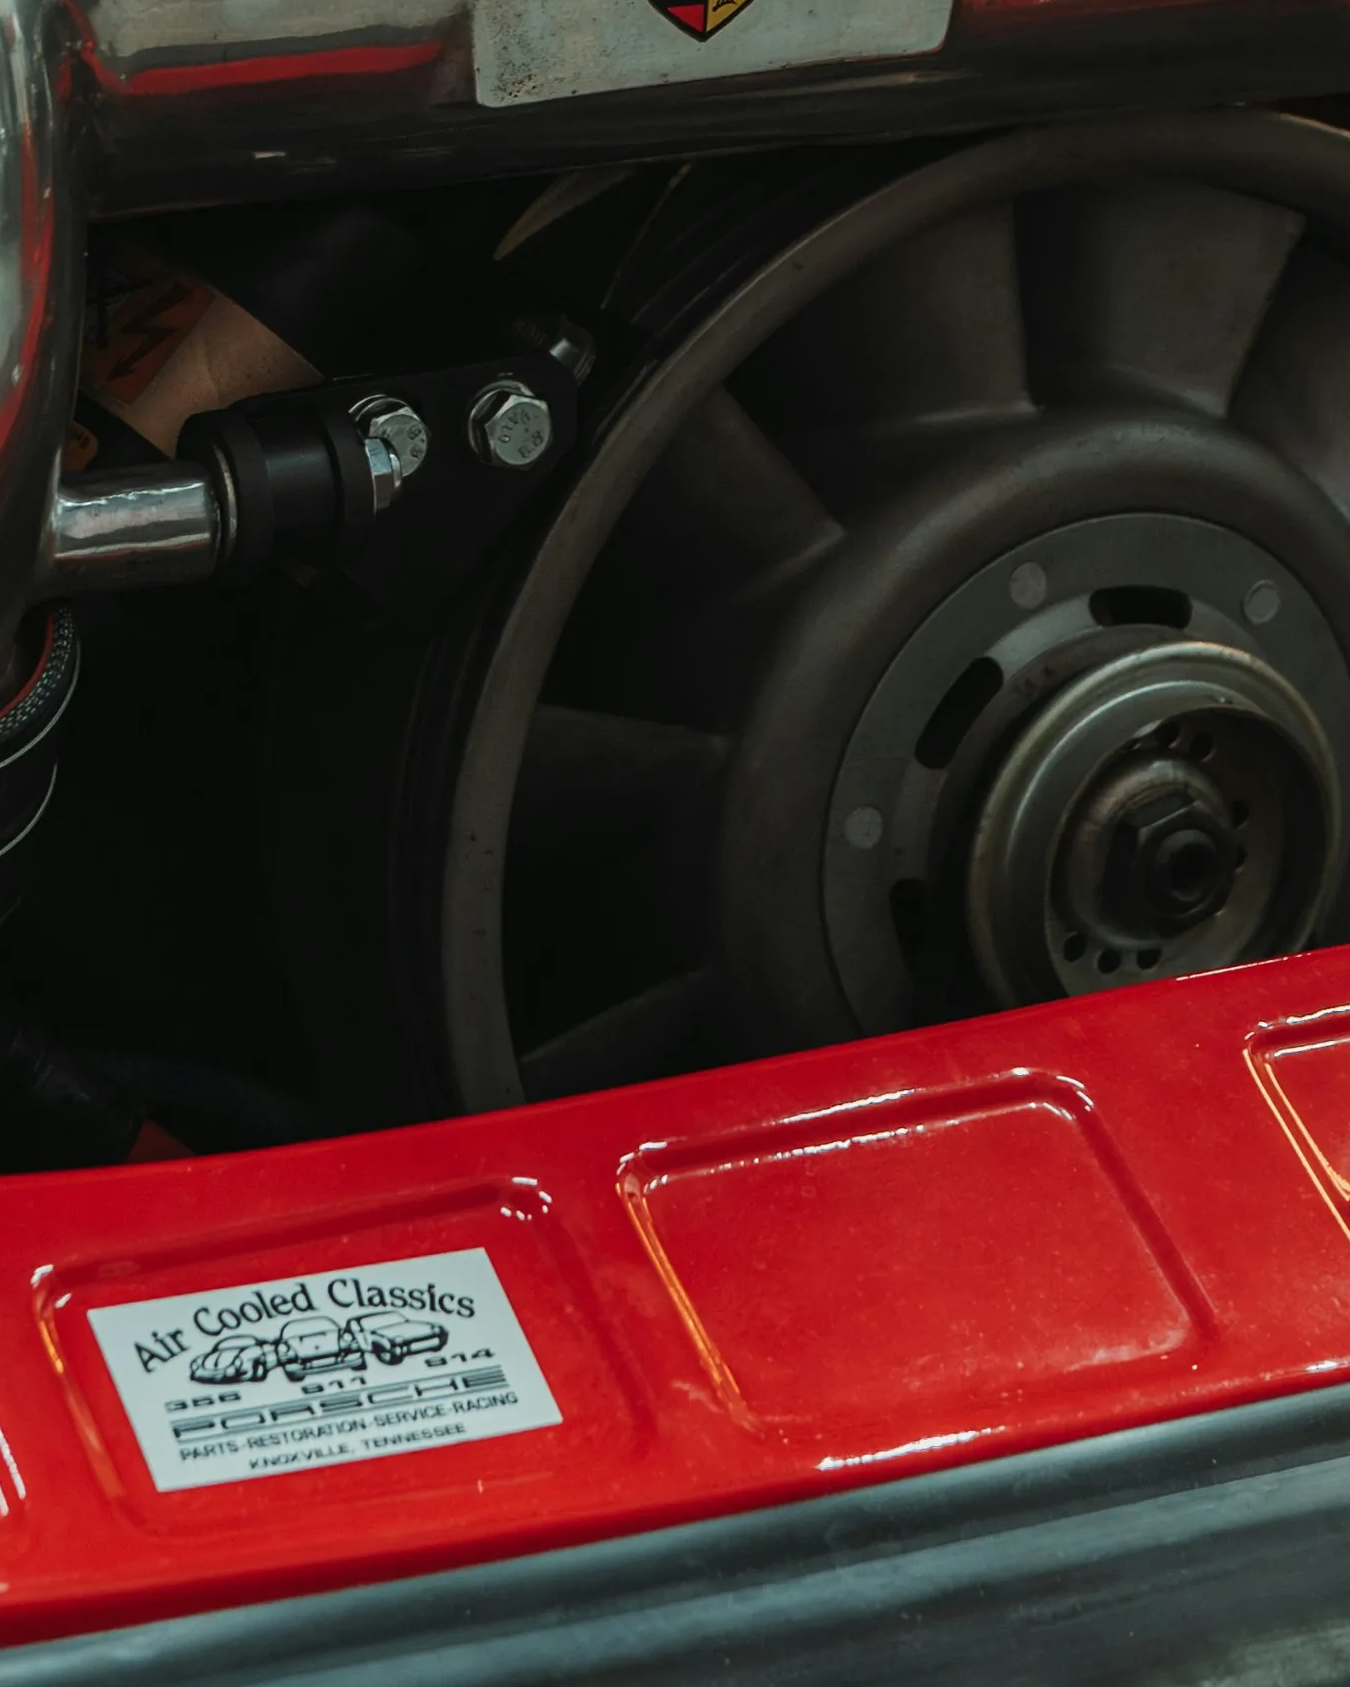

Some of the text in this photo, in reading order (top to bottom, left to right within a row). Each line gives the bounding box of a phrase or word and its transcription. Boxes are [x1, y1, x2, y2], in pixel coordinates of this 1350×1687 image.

[134, 1278, 476, 1374] Air Cooled Classics
[424, 1347, 496, 1368] 914
[302, 1375, 367, 1395] 911
[170, 1366, 509, 1443] PORSCHE
[362, 1422, 467, 1451] TENNESSEE
